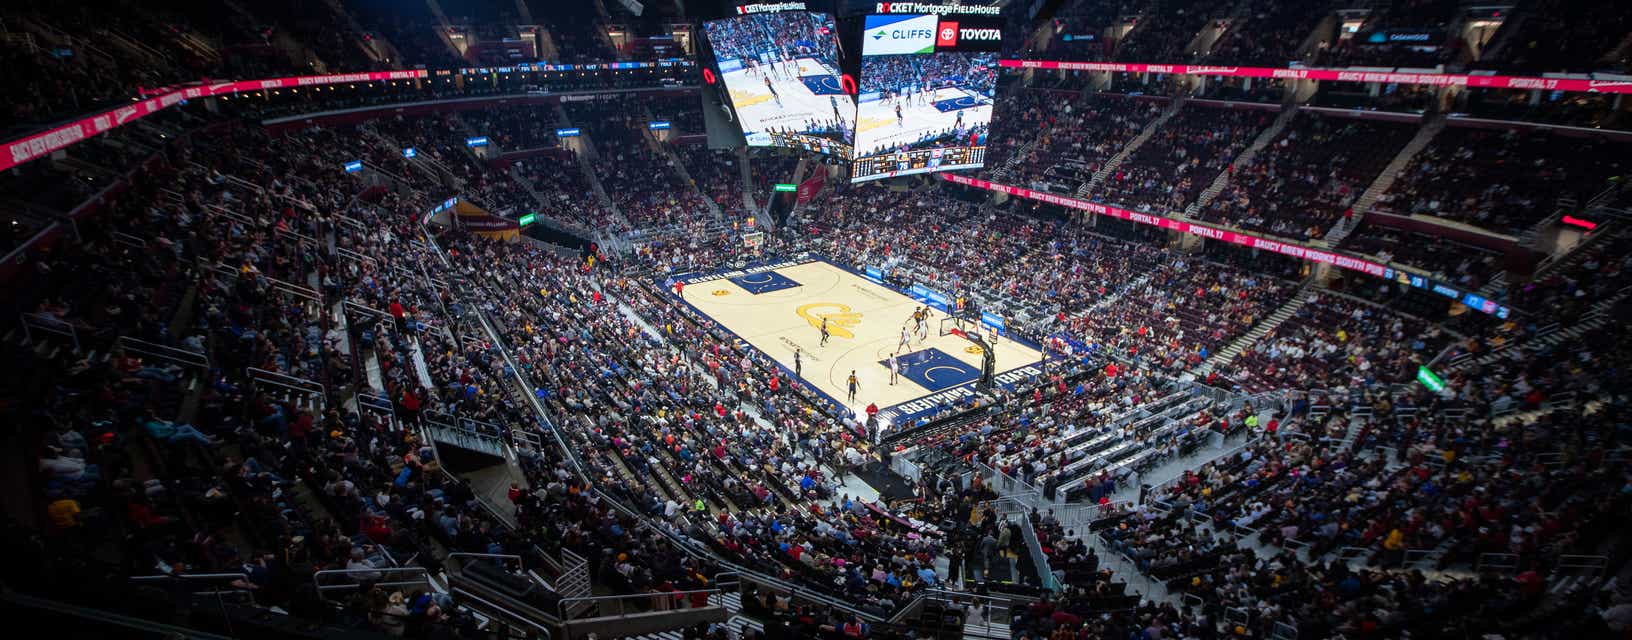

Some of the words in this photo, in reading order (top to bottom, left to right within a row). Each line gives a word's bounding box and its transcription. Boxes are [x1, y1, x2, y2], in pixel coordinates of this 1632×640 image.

[876, 2, 914, 14] ROCKET
[914, 2, 952, 15] Mortgage
[892, 30, 932, 40] CLIFFS
[960, 28, 1002, 40] TOYOTA
[1273, 69, 1298, 78] PORTAL
[1508, 78, 1546, 88] PORTAL
[1130, 212, 1152, 224] PORTAL
[1190, 225, 1215, 238] PORTAL
[1216, 230, 1224, 238] 17
[1254, 238, 1280, 250] SAUCY
[1280, 244, 1304, 257] BREW
[1305, 250, 1336, 263] WORKS
[1336, 256, 1365, 270] SOUTH
[1366, 262, 1384, 276] PUB
[688, 271, 744, 284] CLEVELAND
[898, 386, 975, 414] CAVALIERS
